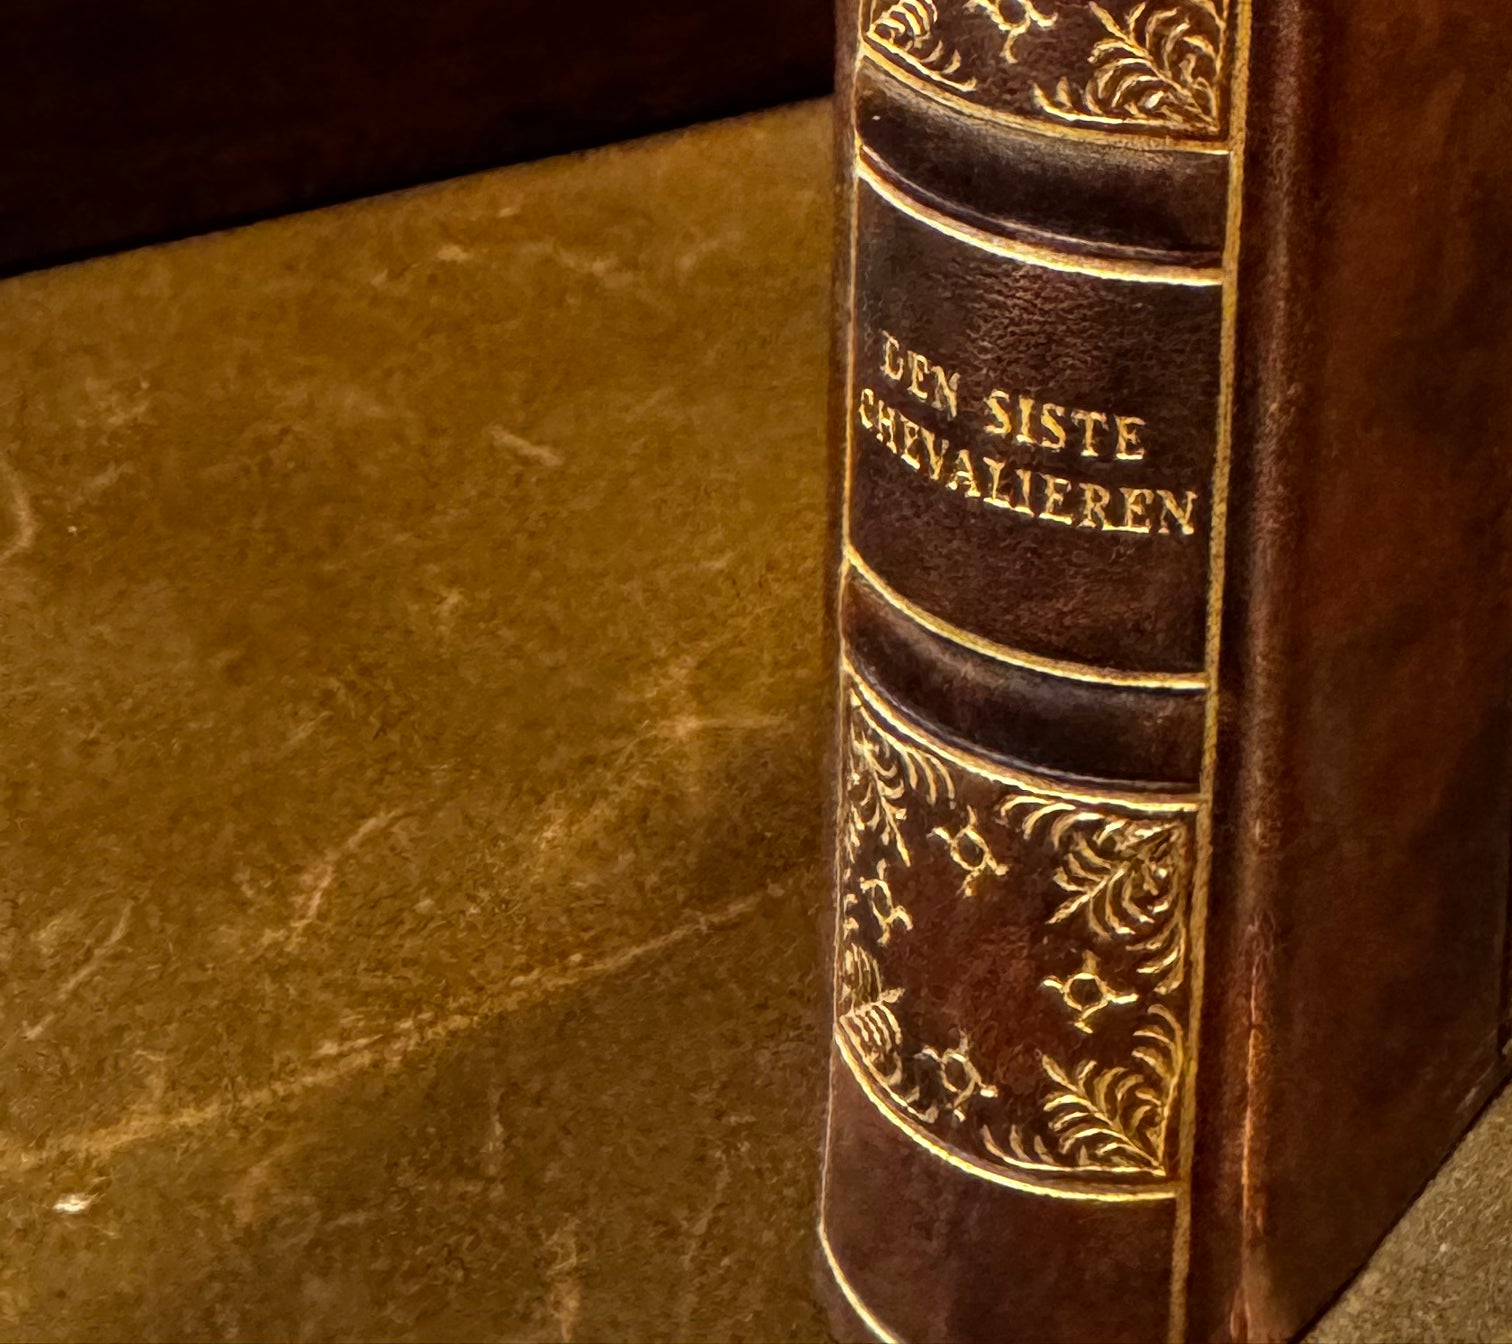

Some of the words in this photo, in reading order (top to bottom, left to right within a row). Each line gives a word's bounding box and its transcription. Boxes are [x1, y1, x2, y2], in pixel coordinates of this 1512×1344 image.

[859, 388, 1198, 535] CHEVALIEREN
[880, 330, 960, 420] DEN
[983, 389, 1146, 460] SISTE
